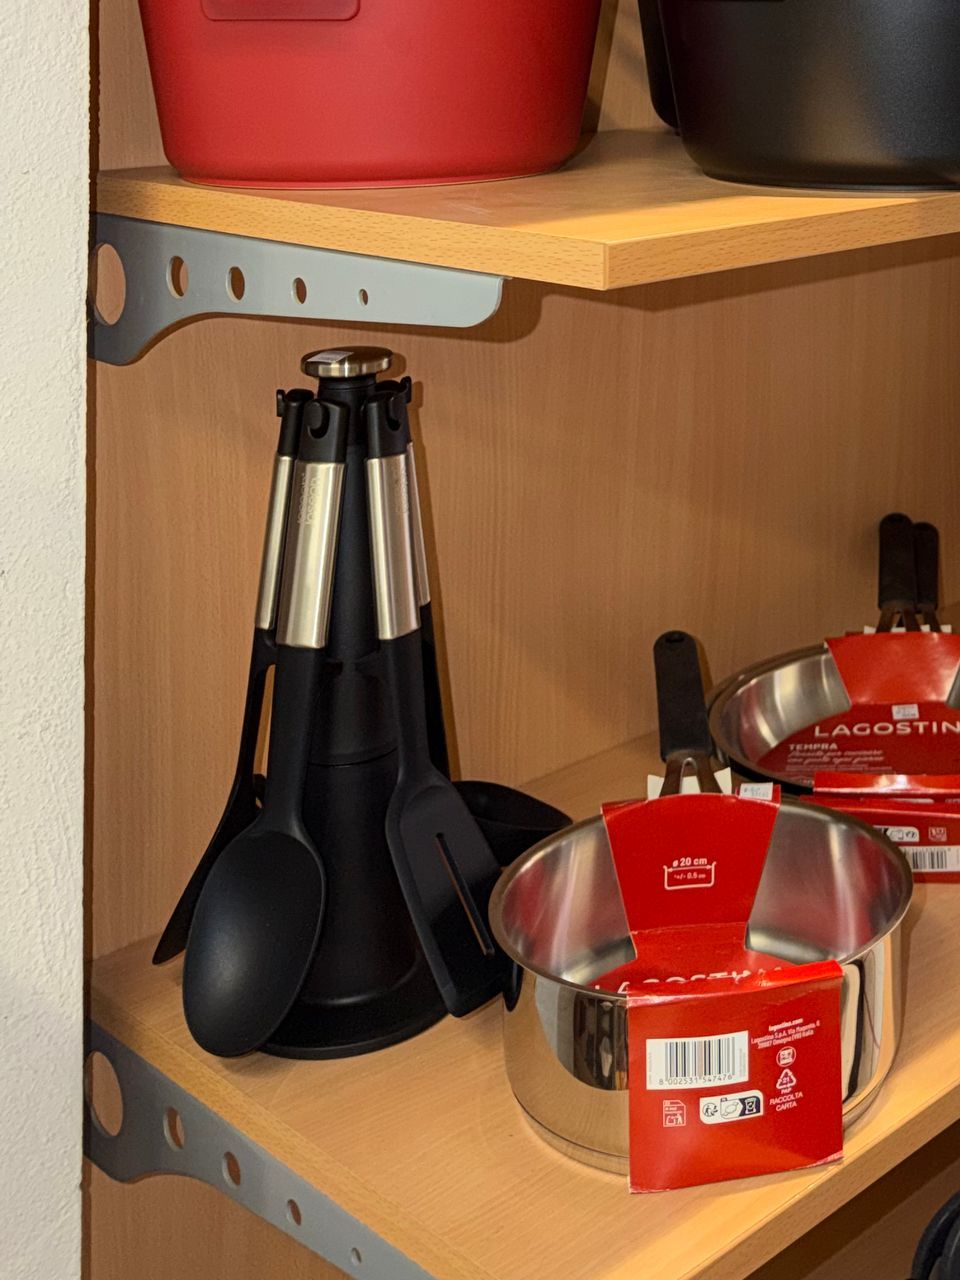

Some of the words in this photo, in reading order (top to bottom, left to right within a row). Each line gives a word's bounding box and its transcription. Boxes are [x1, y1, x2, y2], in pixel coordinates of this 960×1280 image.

[789, 743, 838, 751] TEMPRA
[680, 857, 691, 866] 20
[668, 1076, 698, 1085] 002531
[702, 1074, 733, 1083] 547476
[769, 1091, 803, 1105] RACCOLTA
[776, 1101, 797, 1111] CARTA
